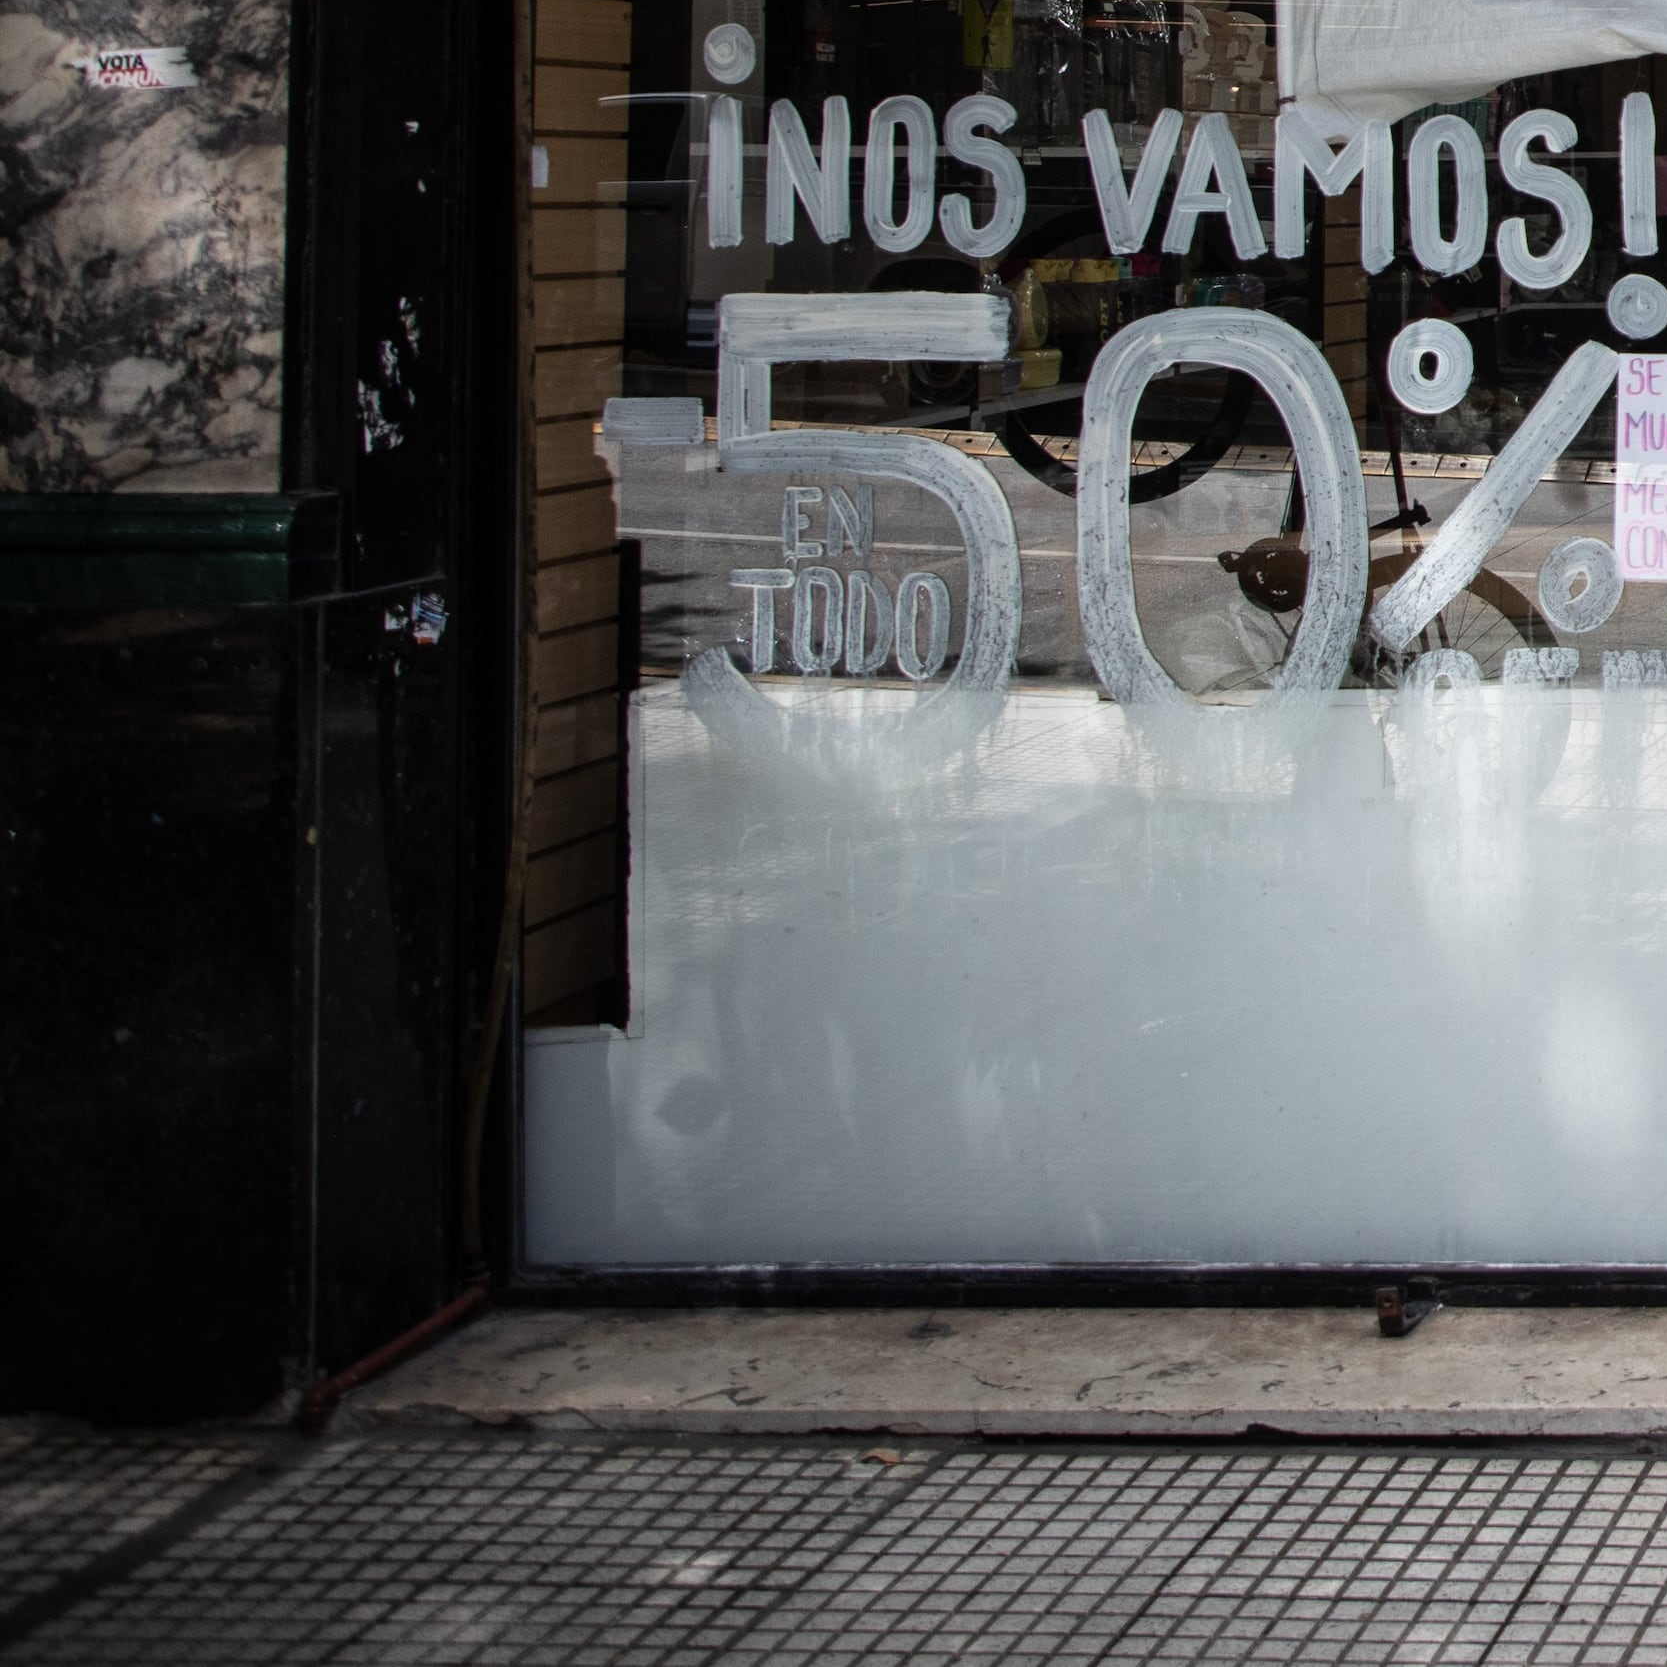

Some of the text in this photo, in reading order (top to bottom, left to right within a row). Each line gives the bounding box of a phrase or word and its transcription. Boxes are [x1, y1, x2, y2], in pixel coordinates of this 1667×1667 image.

[98, 54, 147, 70] VOTA
[1625, 357, 1665, 396] SE
[602, 291, 1625, 761] -50%
[783, 485, 874, 559] EN
[730, 566, 951, 681] TODO
